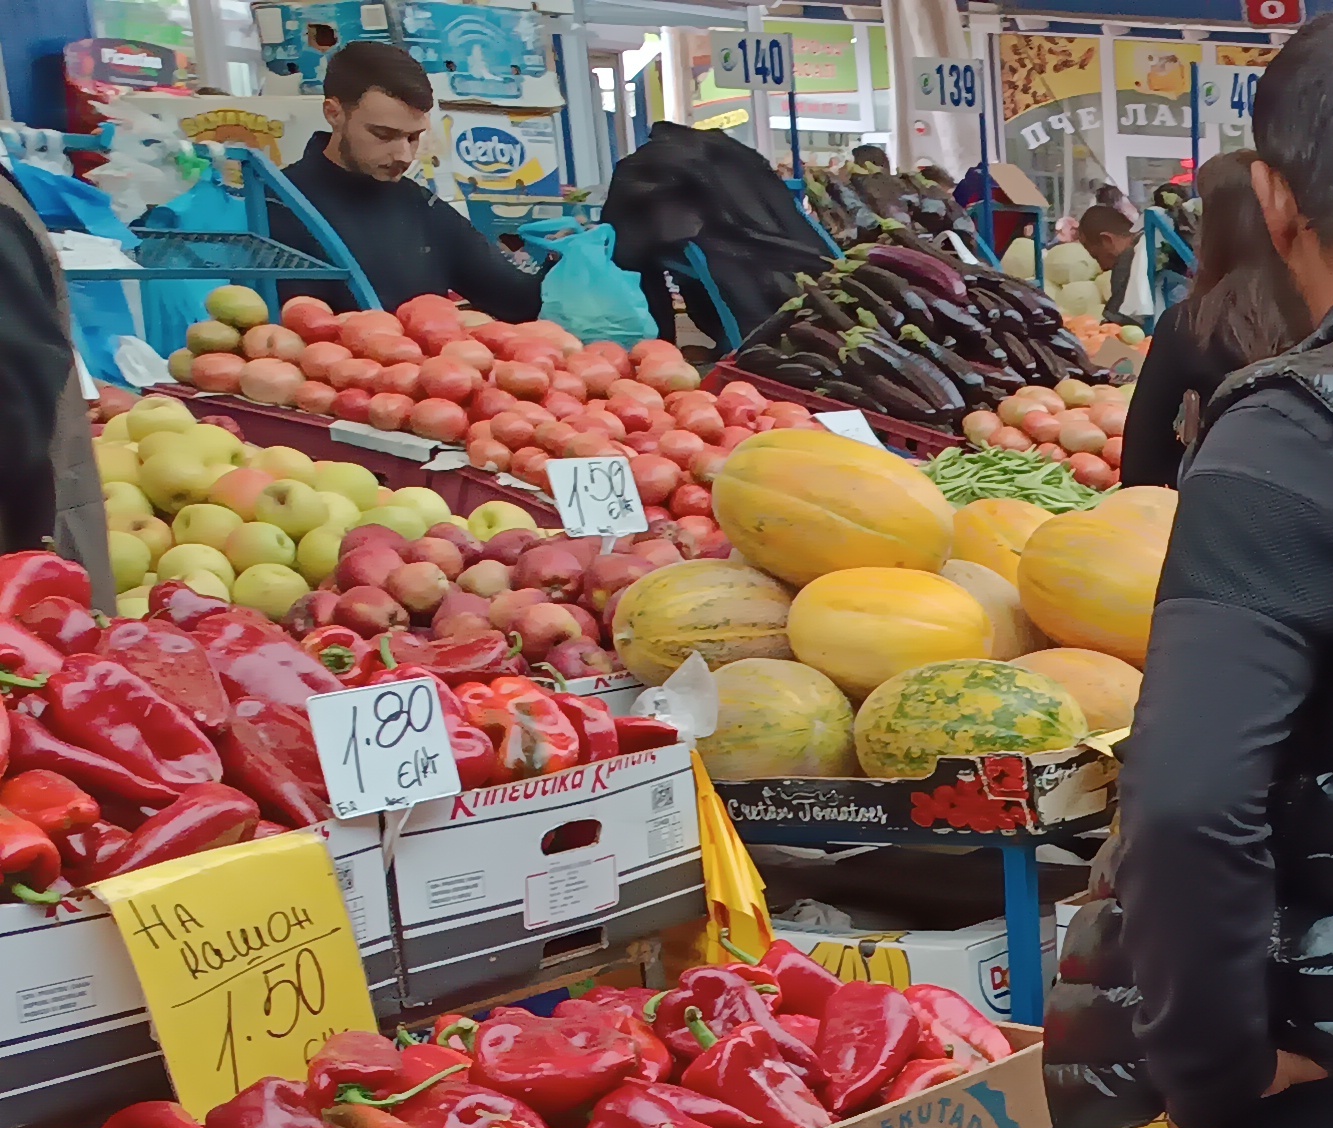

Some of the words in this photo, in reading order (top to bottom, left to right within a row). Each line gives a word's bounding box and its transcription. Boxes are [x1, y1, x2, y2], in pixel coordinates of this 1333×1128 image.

[738, 38, 785, 86] 140
[934, 63, 977, 108] 139
[342, 684, 433, 794] 1.80
[216, 947, 325, 1095] 1.50
